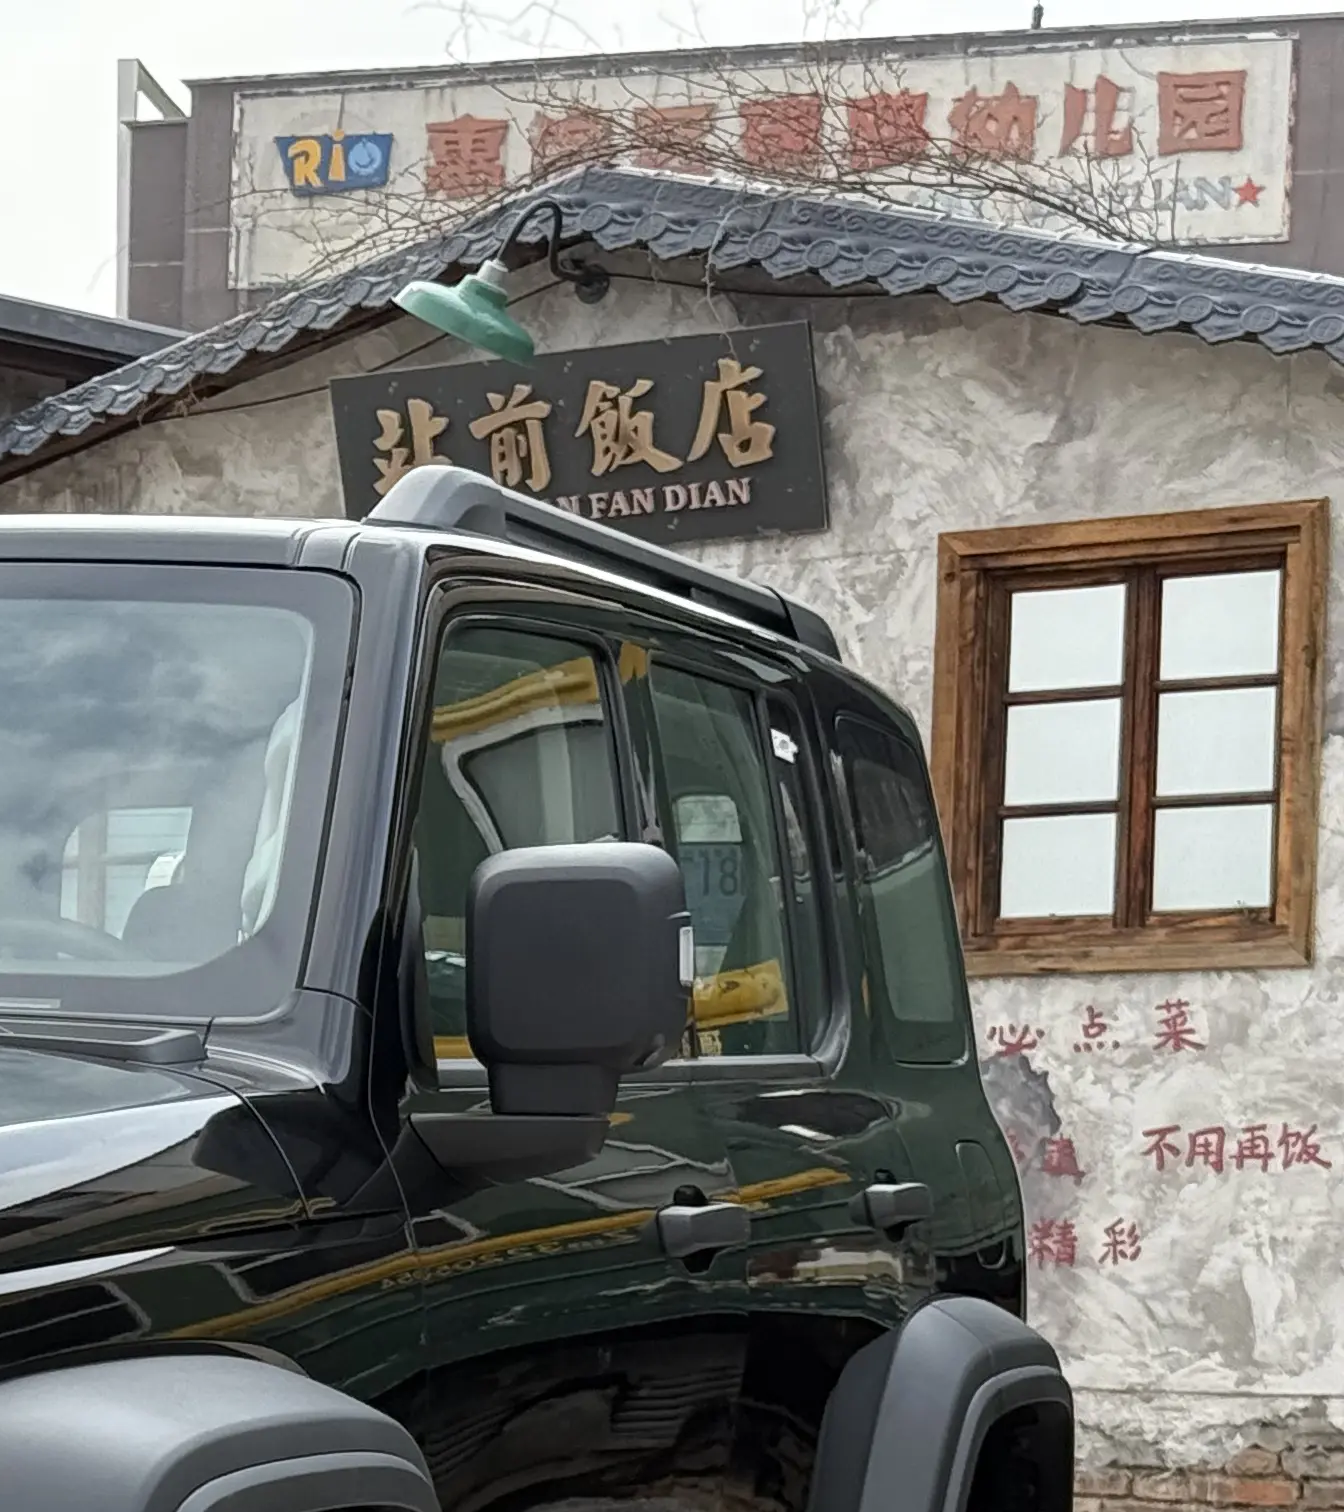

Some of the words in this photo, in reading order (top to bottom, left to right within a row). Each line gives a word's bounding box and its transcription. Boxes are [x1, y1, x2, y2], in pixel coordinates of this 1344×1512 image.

[589, 487, 655, 520] FAN
[662, 476, 752, 512] DIAN
[986, 998, 1206, 1057] 必点菜
[1028, 1216, 1143, 1267] 精彩
